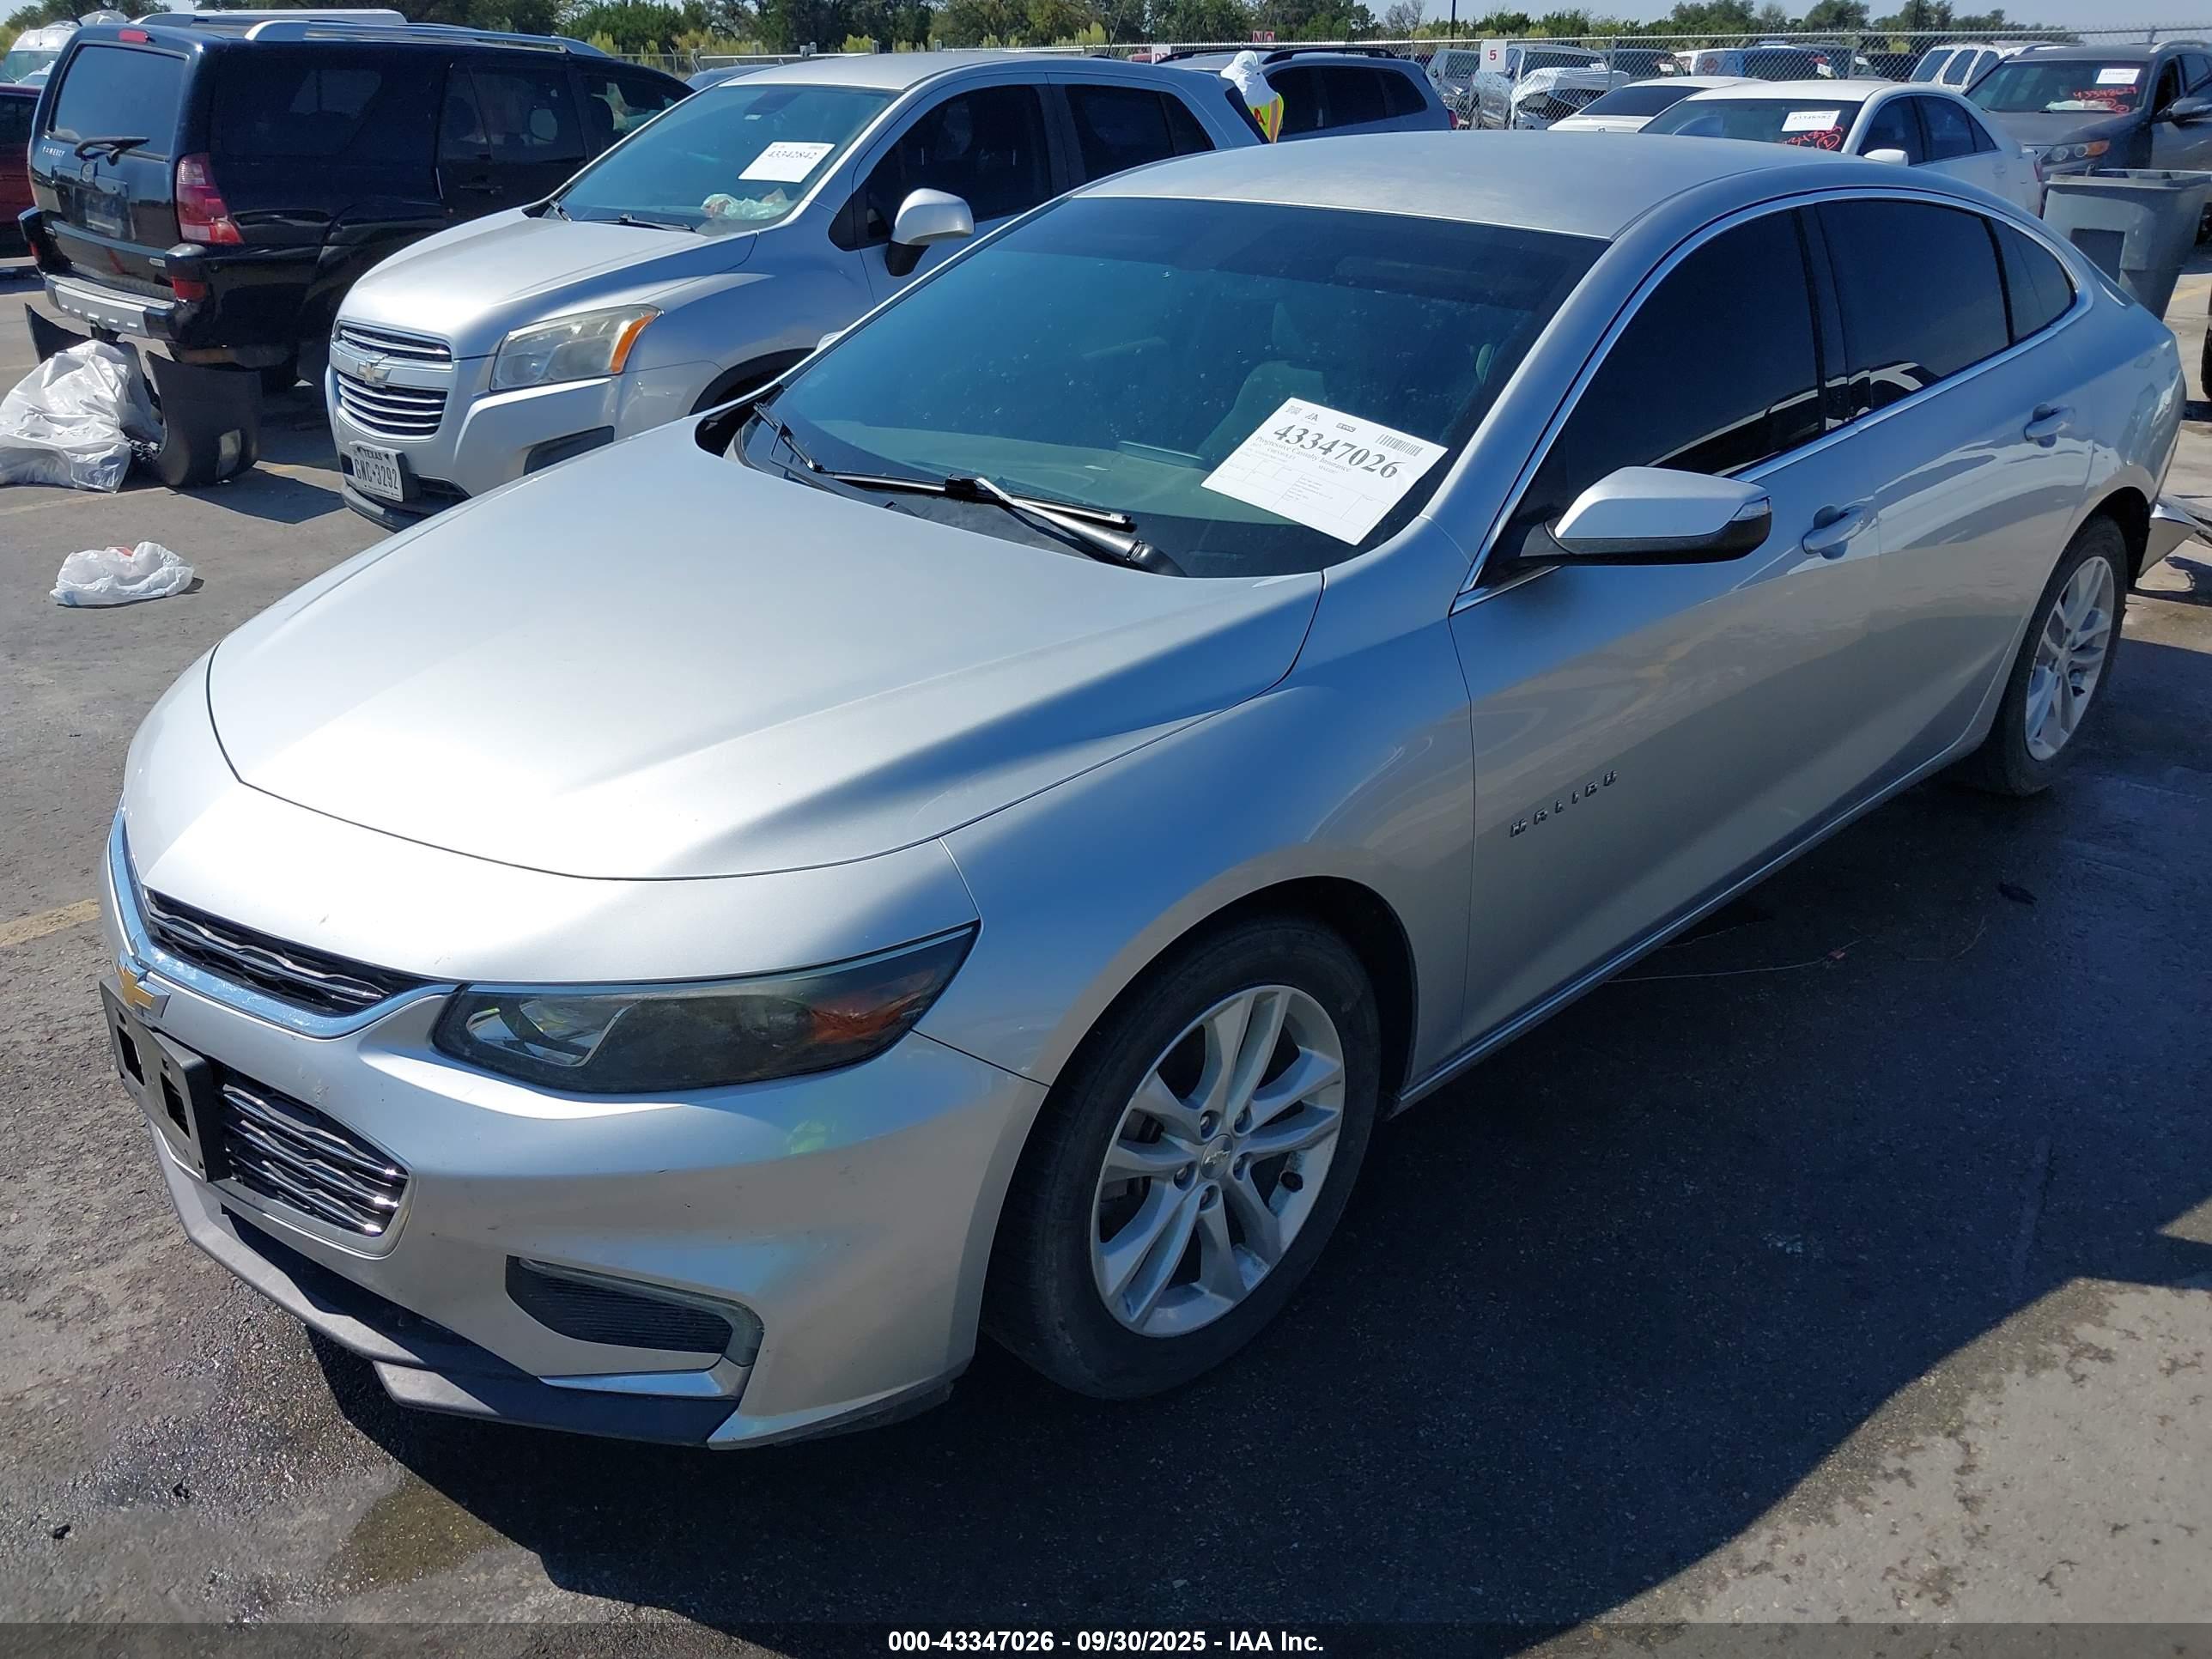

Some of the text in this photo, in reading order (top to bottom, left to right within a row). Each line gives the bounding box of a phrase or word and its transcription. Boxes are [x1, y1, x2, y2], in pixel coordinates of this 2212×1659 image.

[1489, 49, 1497, 61] 5
[363, 449, 383, 461] TEXAS
[1255, 436, 1292, 450] Progressive
[1291, 447, 1318, 462] Casualty
[1319, 458, 1352, 473] Insurance
[1273, 424, 1407, 478] 43347026
